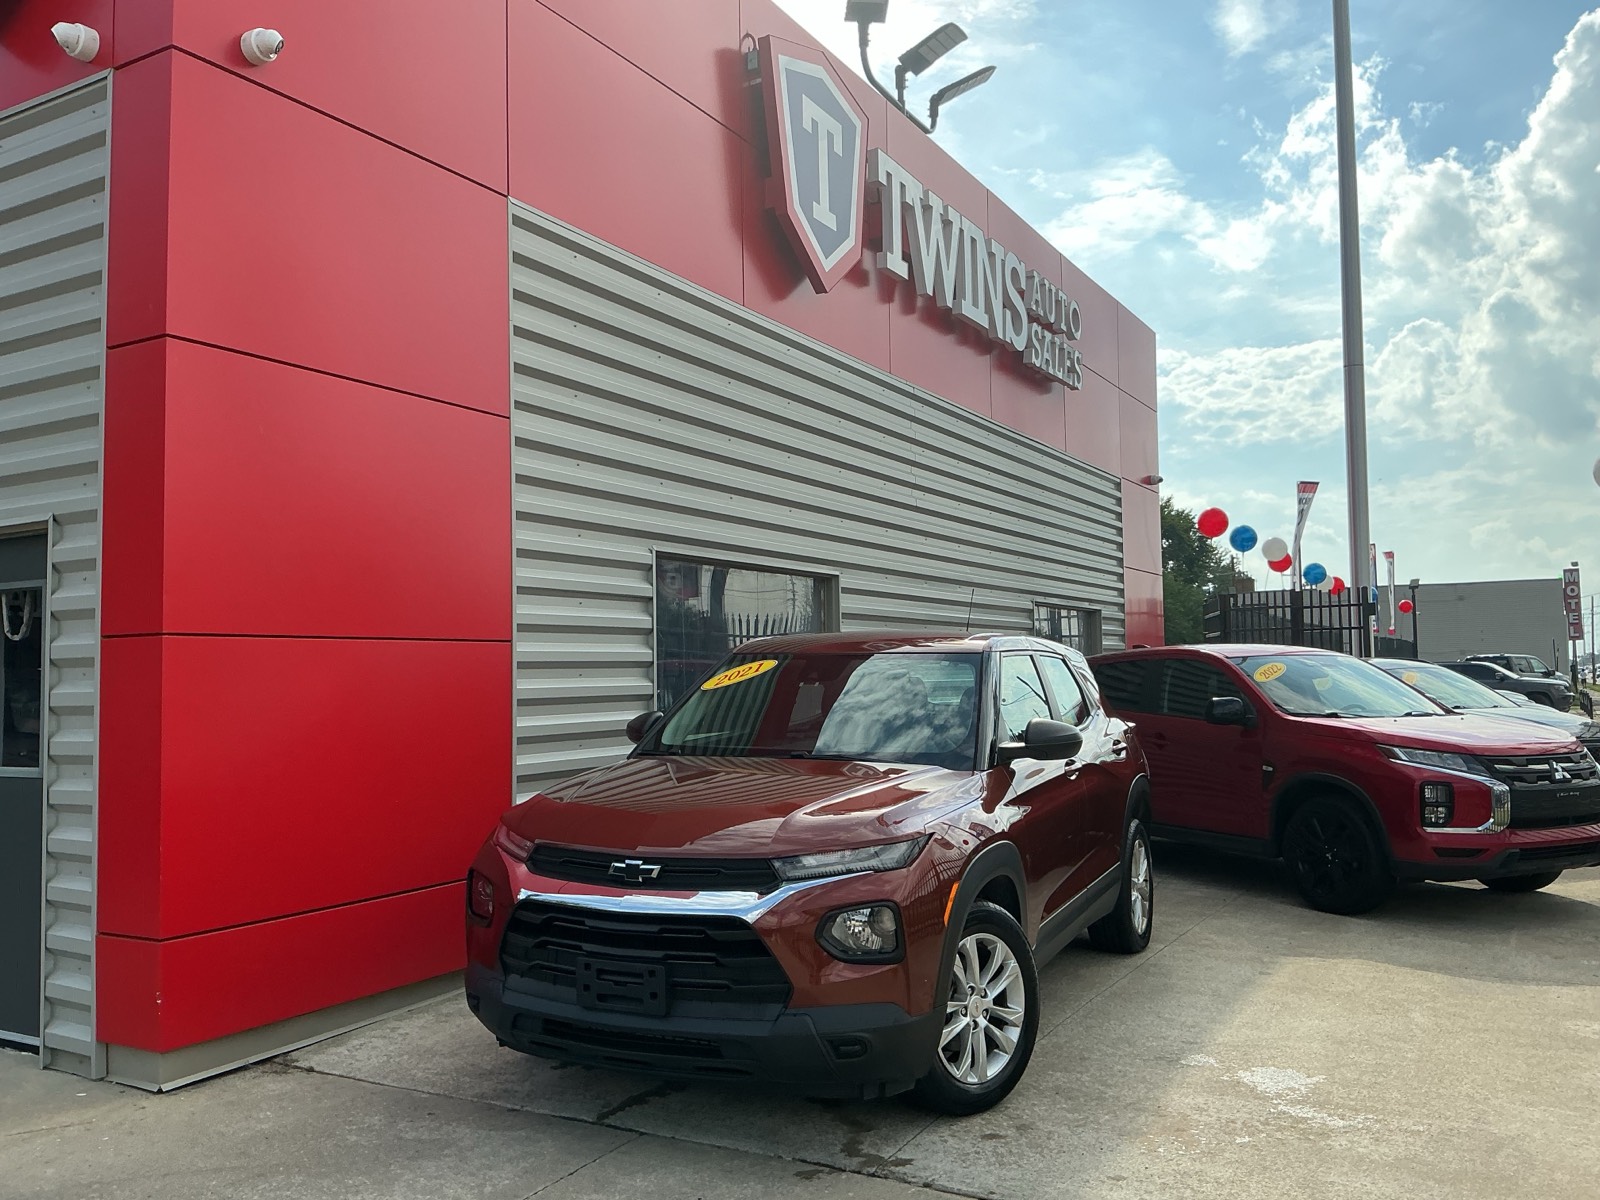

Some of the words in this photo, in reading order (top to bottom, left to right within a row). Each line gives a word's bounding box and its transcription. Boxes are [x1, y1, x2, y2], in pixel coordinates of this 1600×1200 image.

[802, 94, 843, 231] T
[870, 147, 1028, 351] TWINS
[1028, 269, 1082, 340] AUTO
[1027, 321, 1082, 390] SALES
[1564, 571, 1580, 637] MOTEL
[713, 662, 765, 687] 2021
[1258, 663, 1282, 680] 2022
